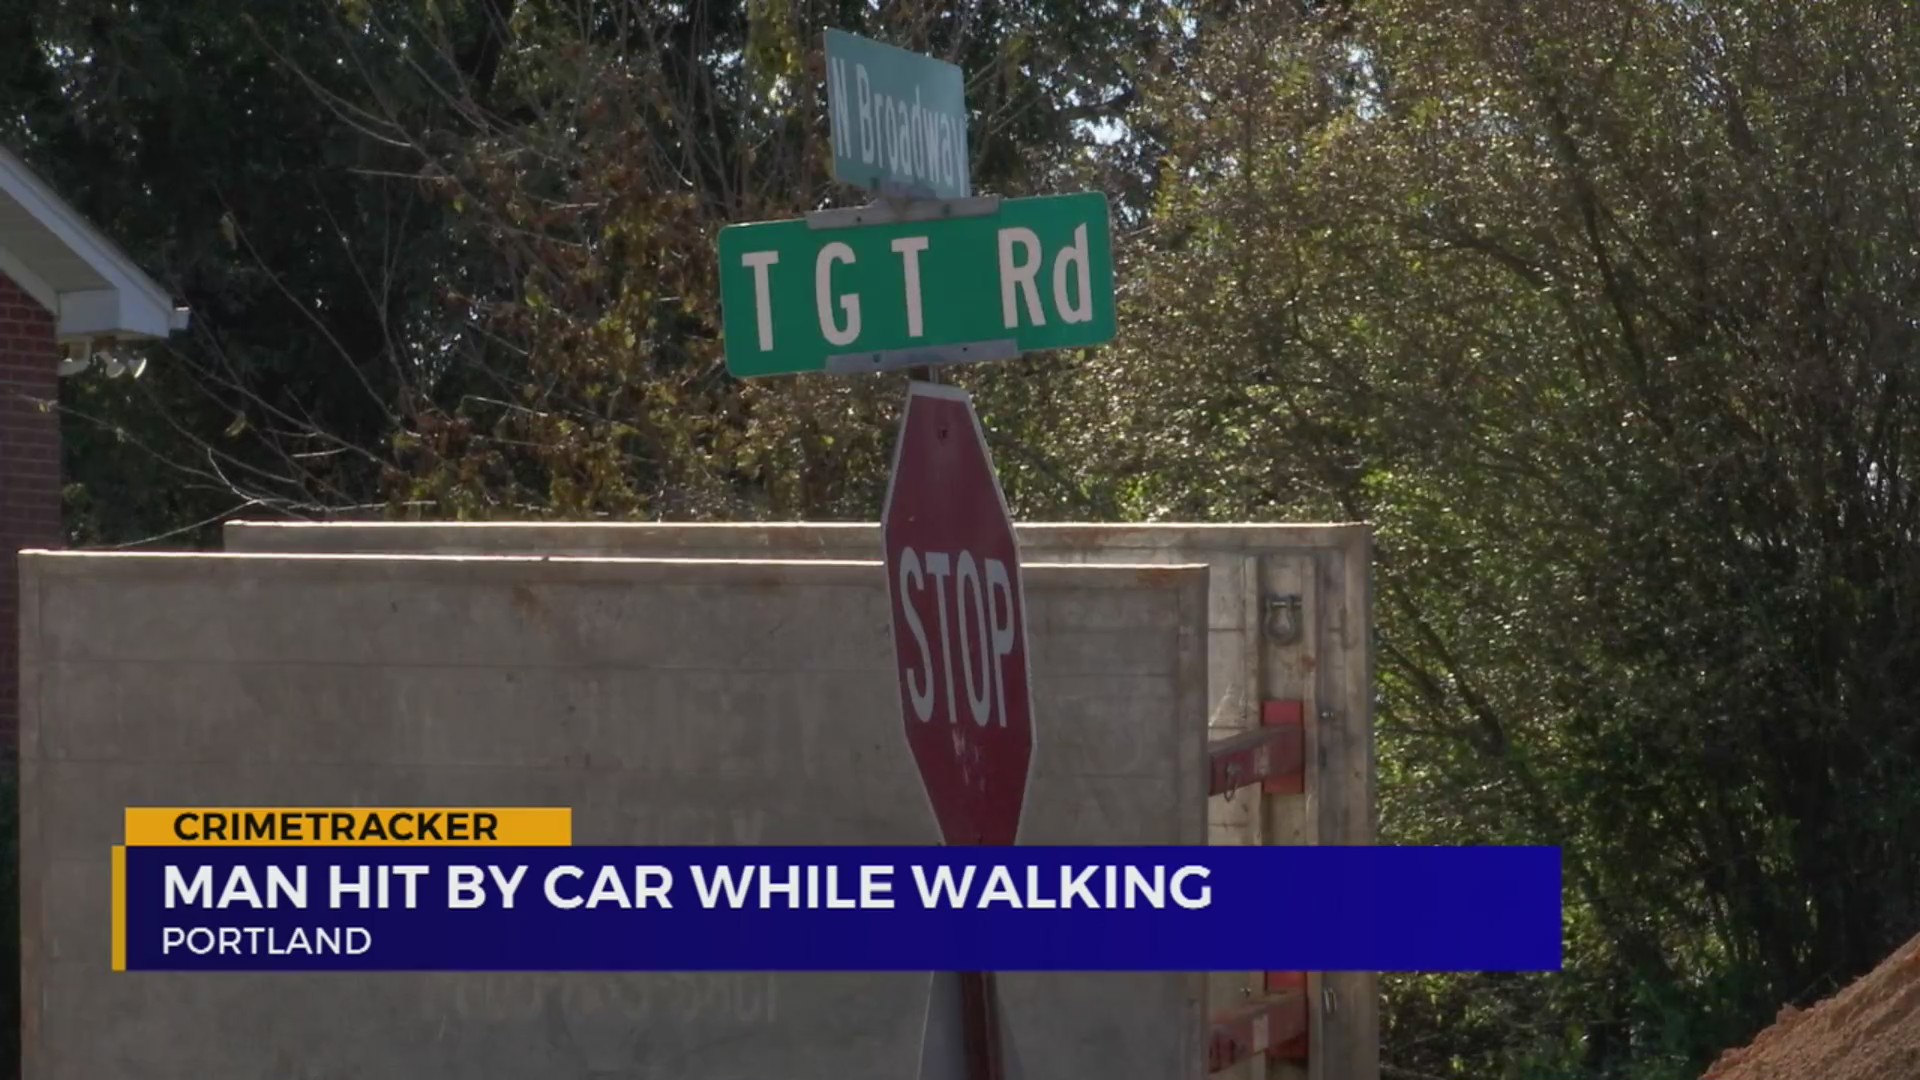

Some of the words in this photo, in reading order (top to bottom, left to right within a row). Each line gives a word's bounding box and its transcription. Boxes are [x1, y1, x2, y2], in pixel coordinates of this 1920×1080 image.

[831, 57, 852, 159] N
[856, 63, 966, 198] Broadway
[998, 223, 1093, 329] Rd
[900, 546, 1016, 728] STOP
